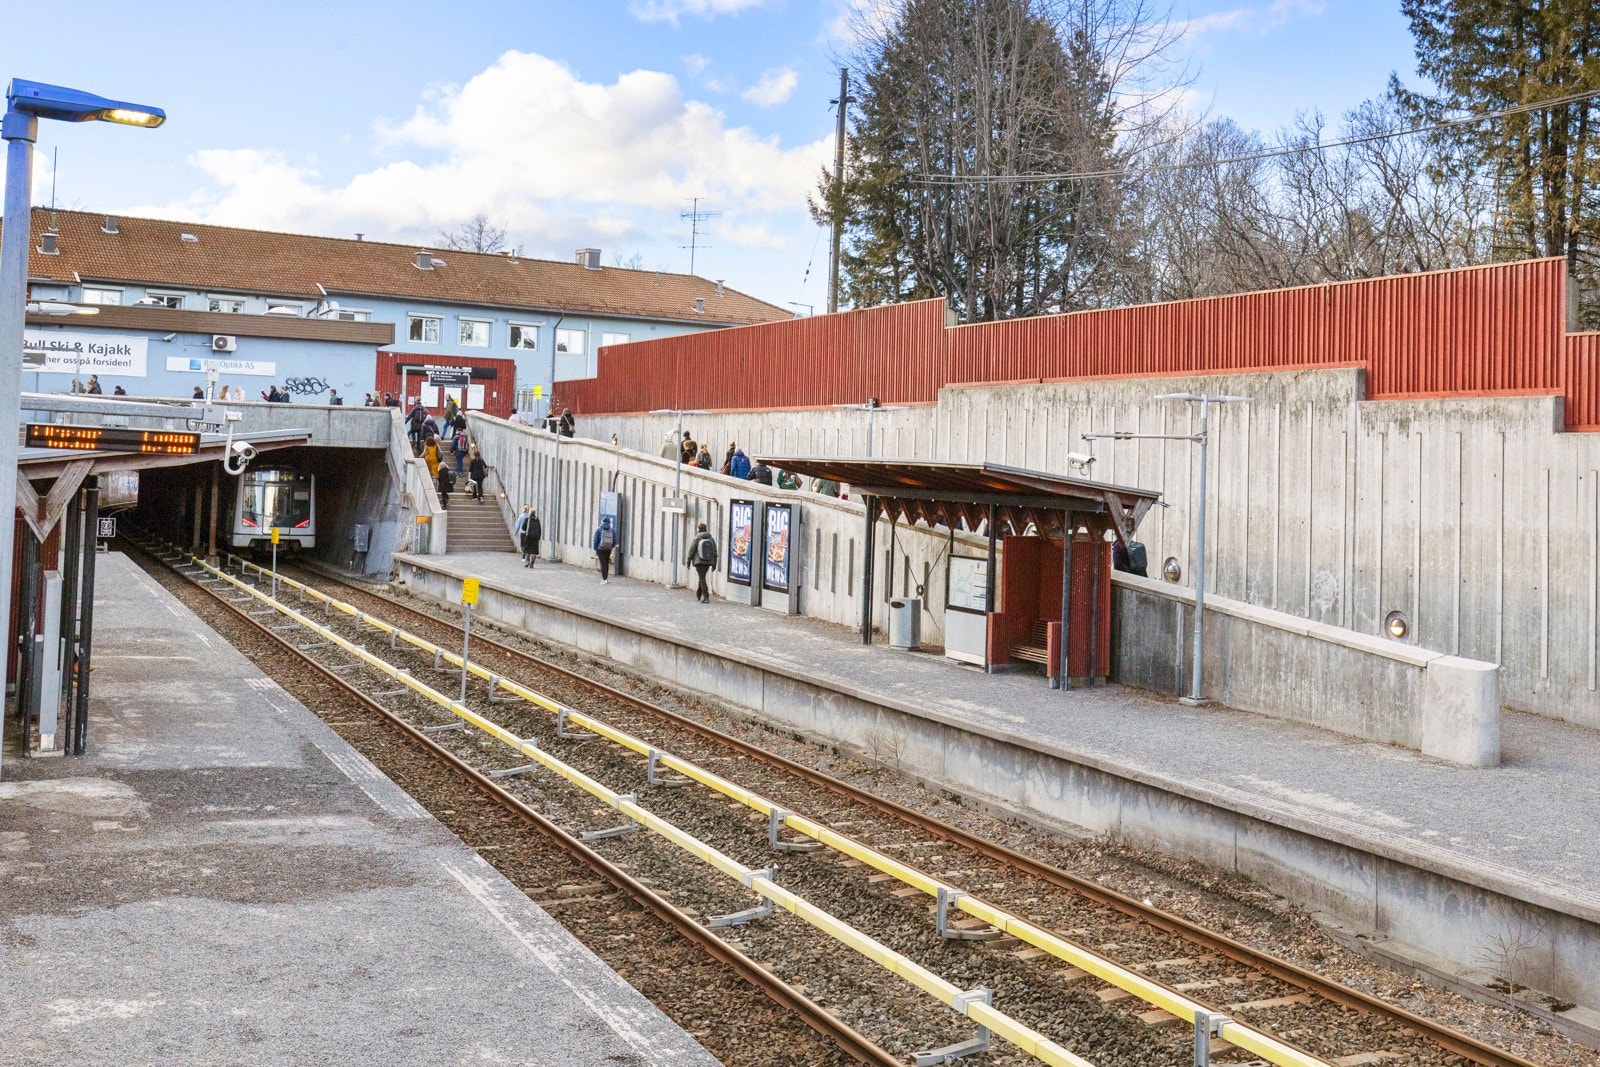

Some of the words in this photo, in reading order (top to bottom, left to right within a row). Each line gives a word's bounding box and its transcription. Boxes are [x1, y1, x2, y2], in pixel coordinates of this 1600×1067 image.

[88, 343, 132, 357] Kajakk
[93, 358, 132, 367] forsiden!
[219, 360, 244, 370] Optikk
[245, 362, 255, 370] AS
